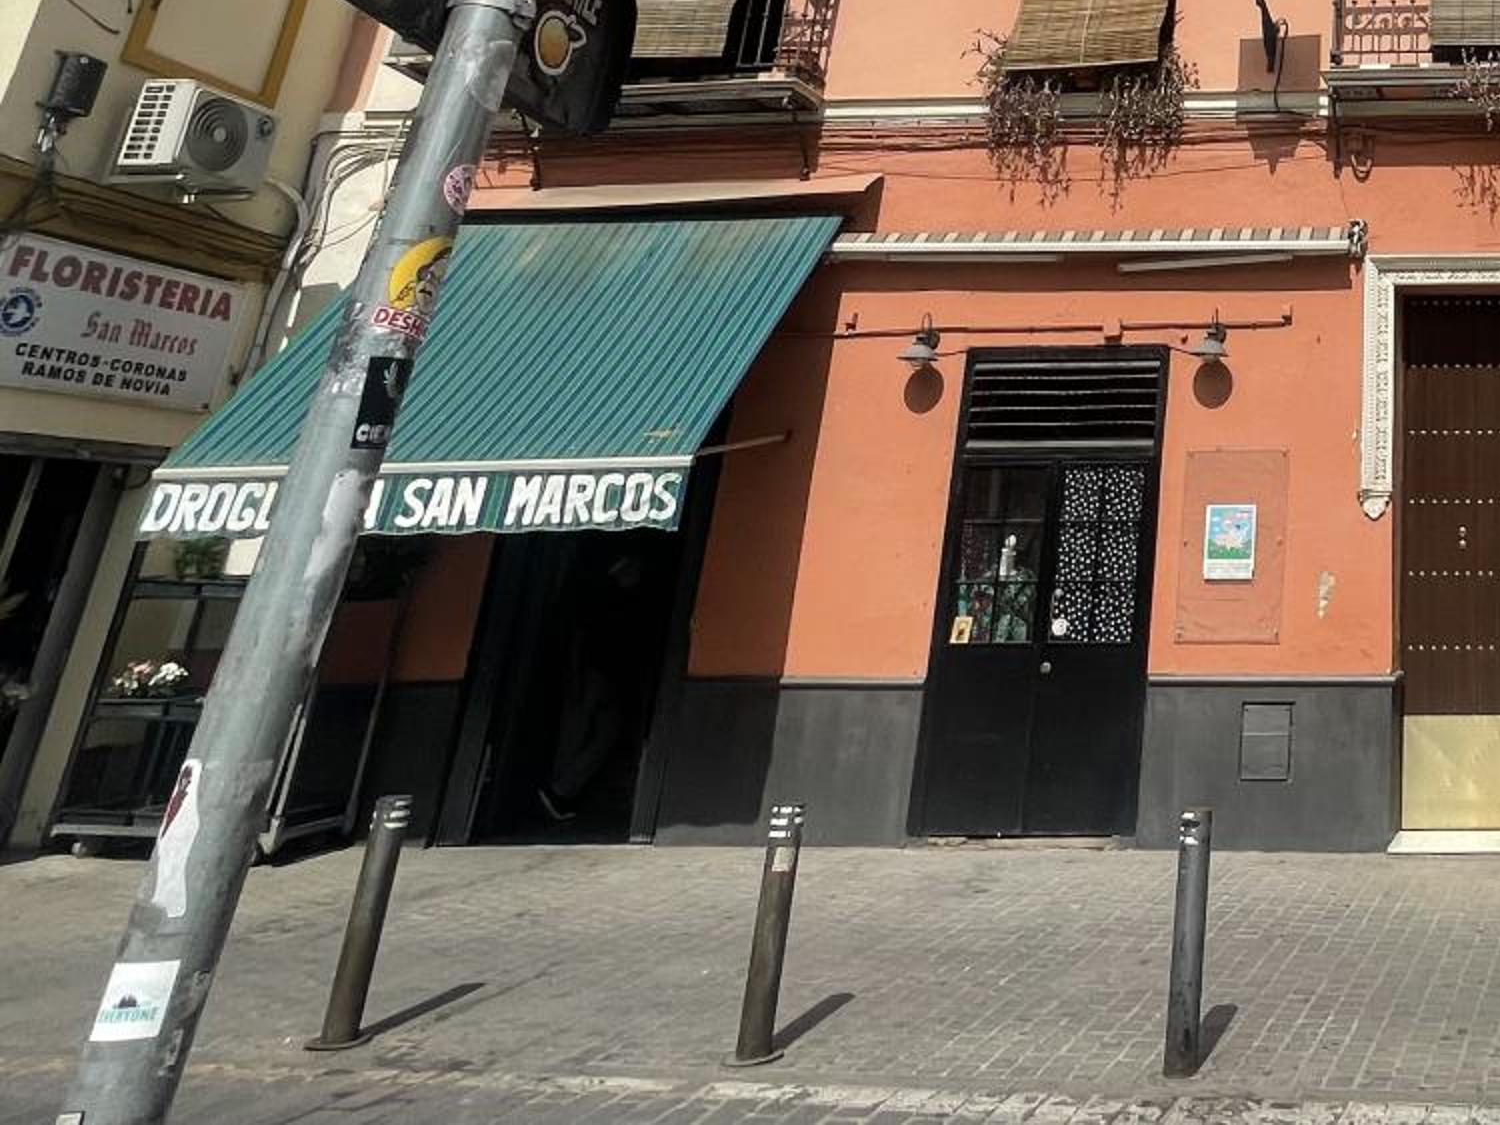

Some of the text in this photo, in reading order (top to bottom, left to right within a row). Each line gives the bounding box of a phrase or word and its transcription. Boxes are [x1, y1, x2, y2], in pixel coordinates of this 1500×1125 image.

[9, 244, 232, 322] FLORISTERIA
[80, 310, 123, 345] San
[128, 318, 199, 357] Marcos
[20, 361, 171, 396] RAMOS DE NOVIA
[393, 475, 488, 528] SAN
[503, 473, 684, 527] MARCOS
